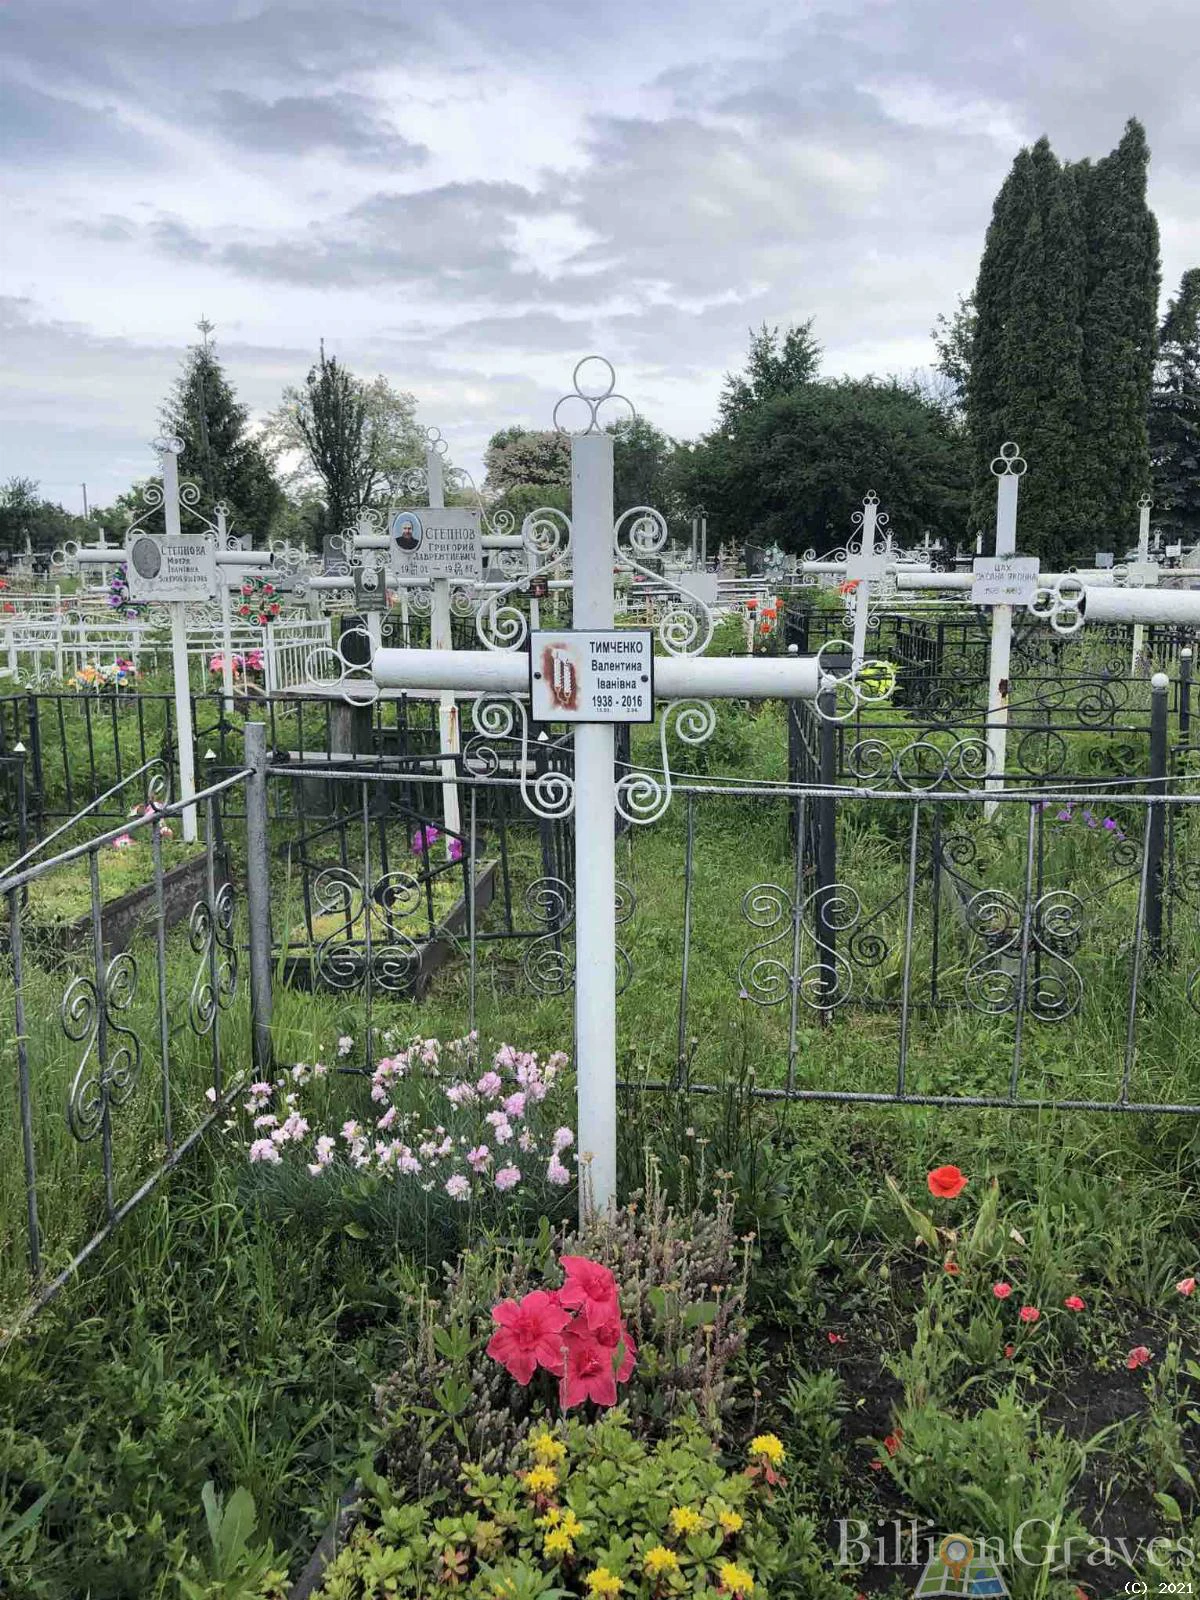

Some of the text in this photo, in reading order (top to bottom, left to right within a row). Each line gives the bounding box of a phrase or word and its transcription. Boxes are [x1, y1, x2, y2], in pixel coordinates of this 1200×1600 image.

[425, 528, 476, 540] СТЕПНОВ
[590, 641, 643, 653] ТИМЧЕНКО
[591, 660, 642, 671] Валентина
[597, 677, 636, 689] Іванівна
[592, 695, 613, 707] 1938
[621, 695, 642, 707] 2016
